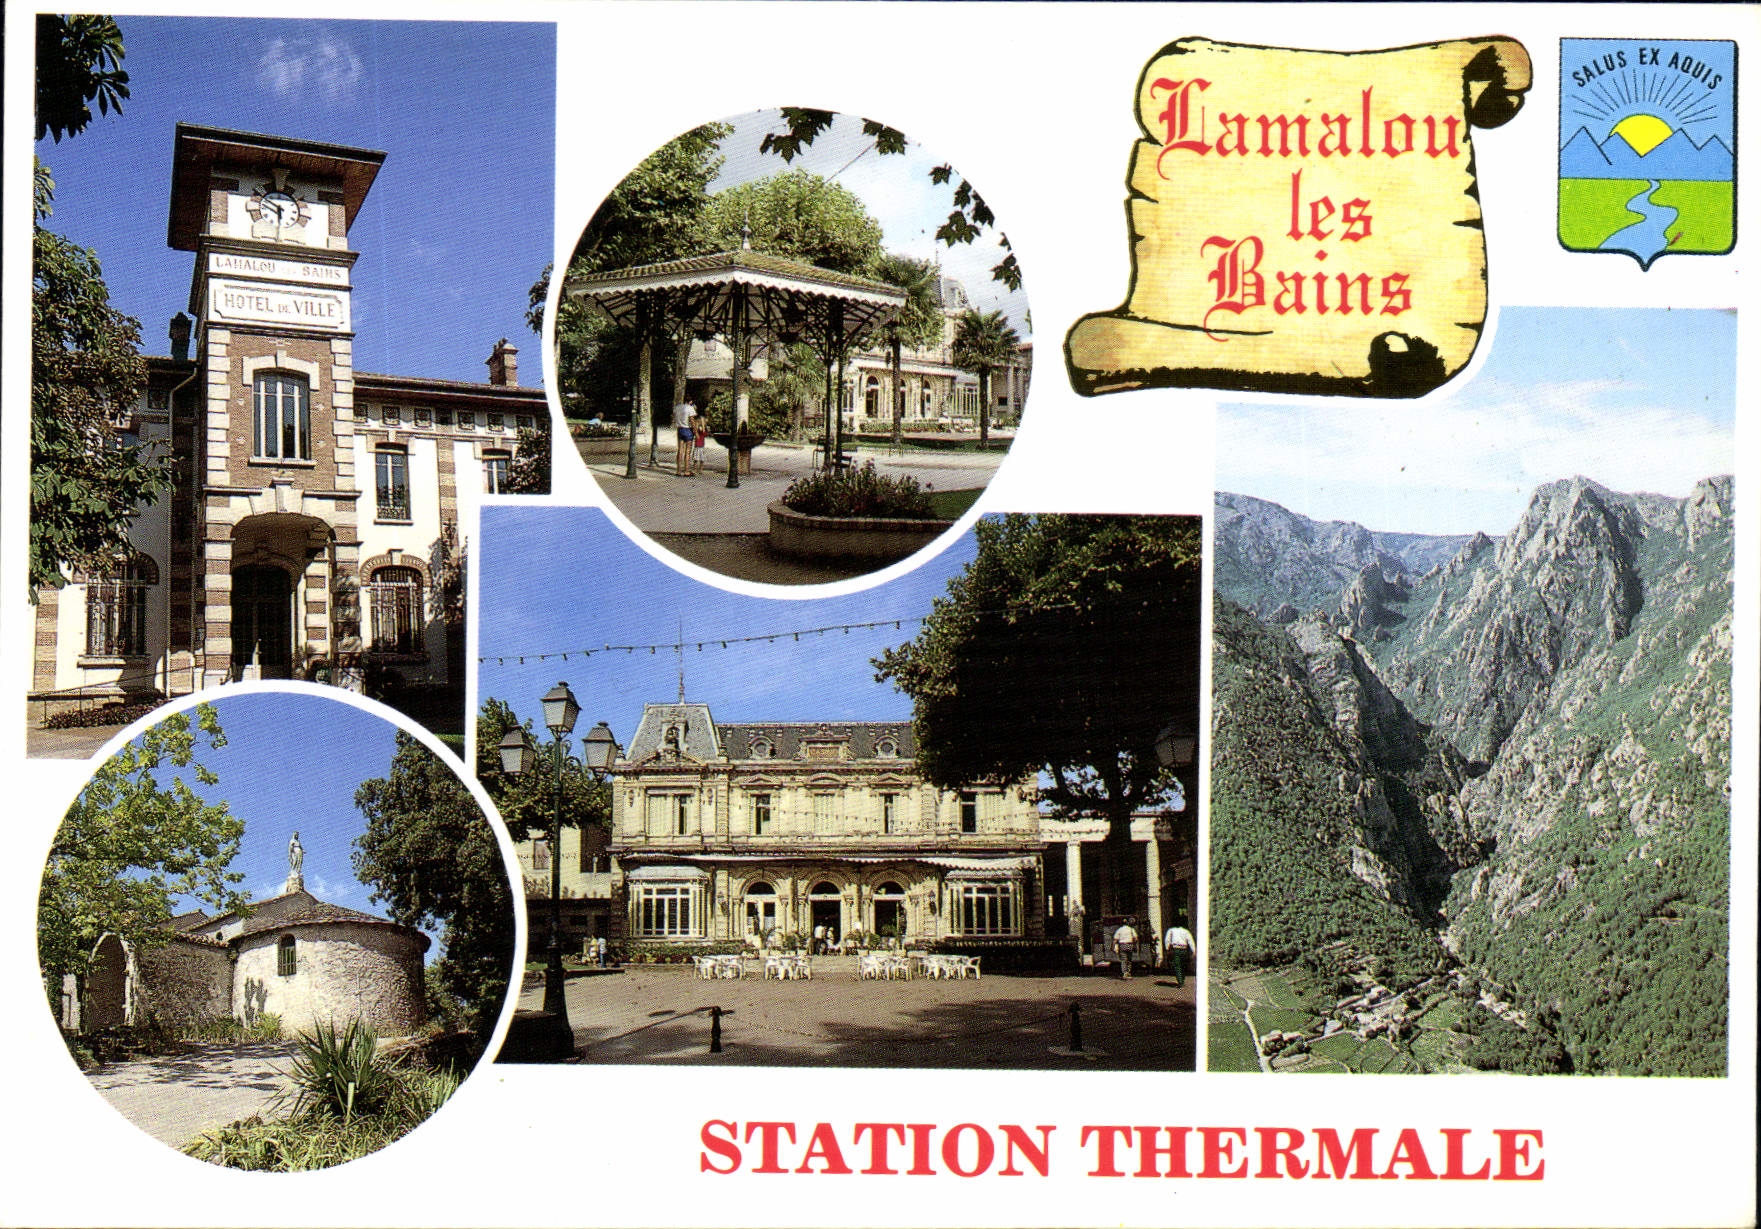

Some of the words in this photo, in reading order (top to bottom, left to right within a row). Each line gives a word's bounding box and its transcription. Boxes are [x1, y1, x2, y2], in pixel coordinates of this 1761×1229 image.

[1572, 51, 1627, 87] SALUS
[1639, 48, 1661, 66] EX
[1668, 52, 1722, 90] AQUIS
[1150, 77, 1465, 181] Lamalou
[1287, 169, 1373, 242] les
[224, 293, 274, 312] HOTEL
[293, 300, 335, 317] VILLE
[1202, 235, 1412, 342] Bains
[701, 1120, 1057, 1178] STATION
[1081, 1126, 1545, 1181] THERMALE
